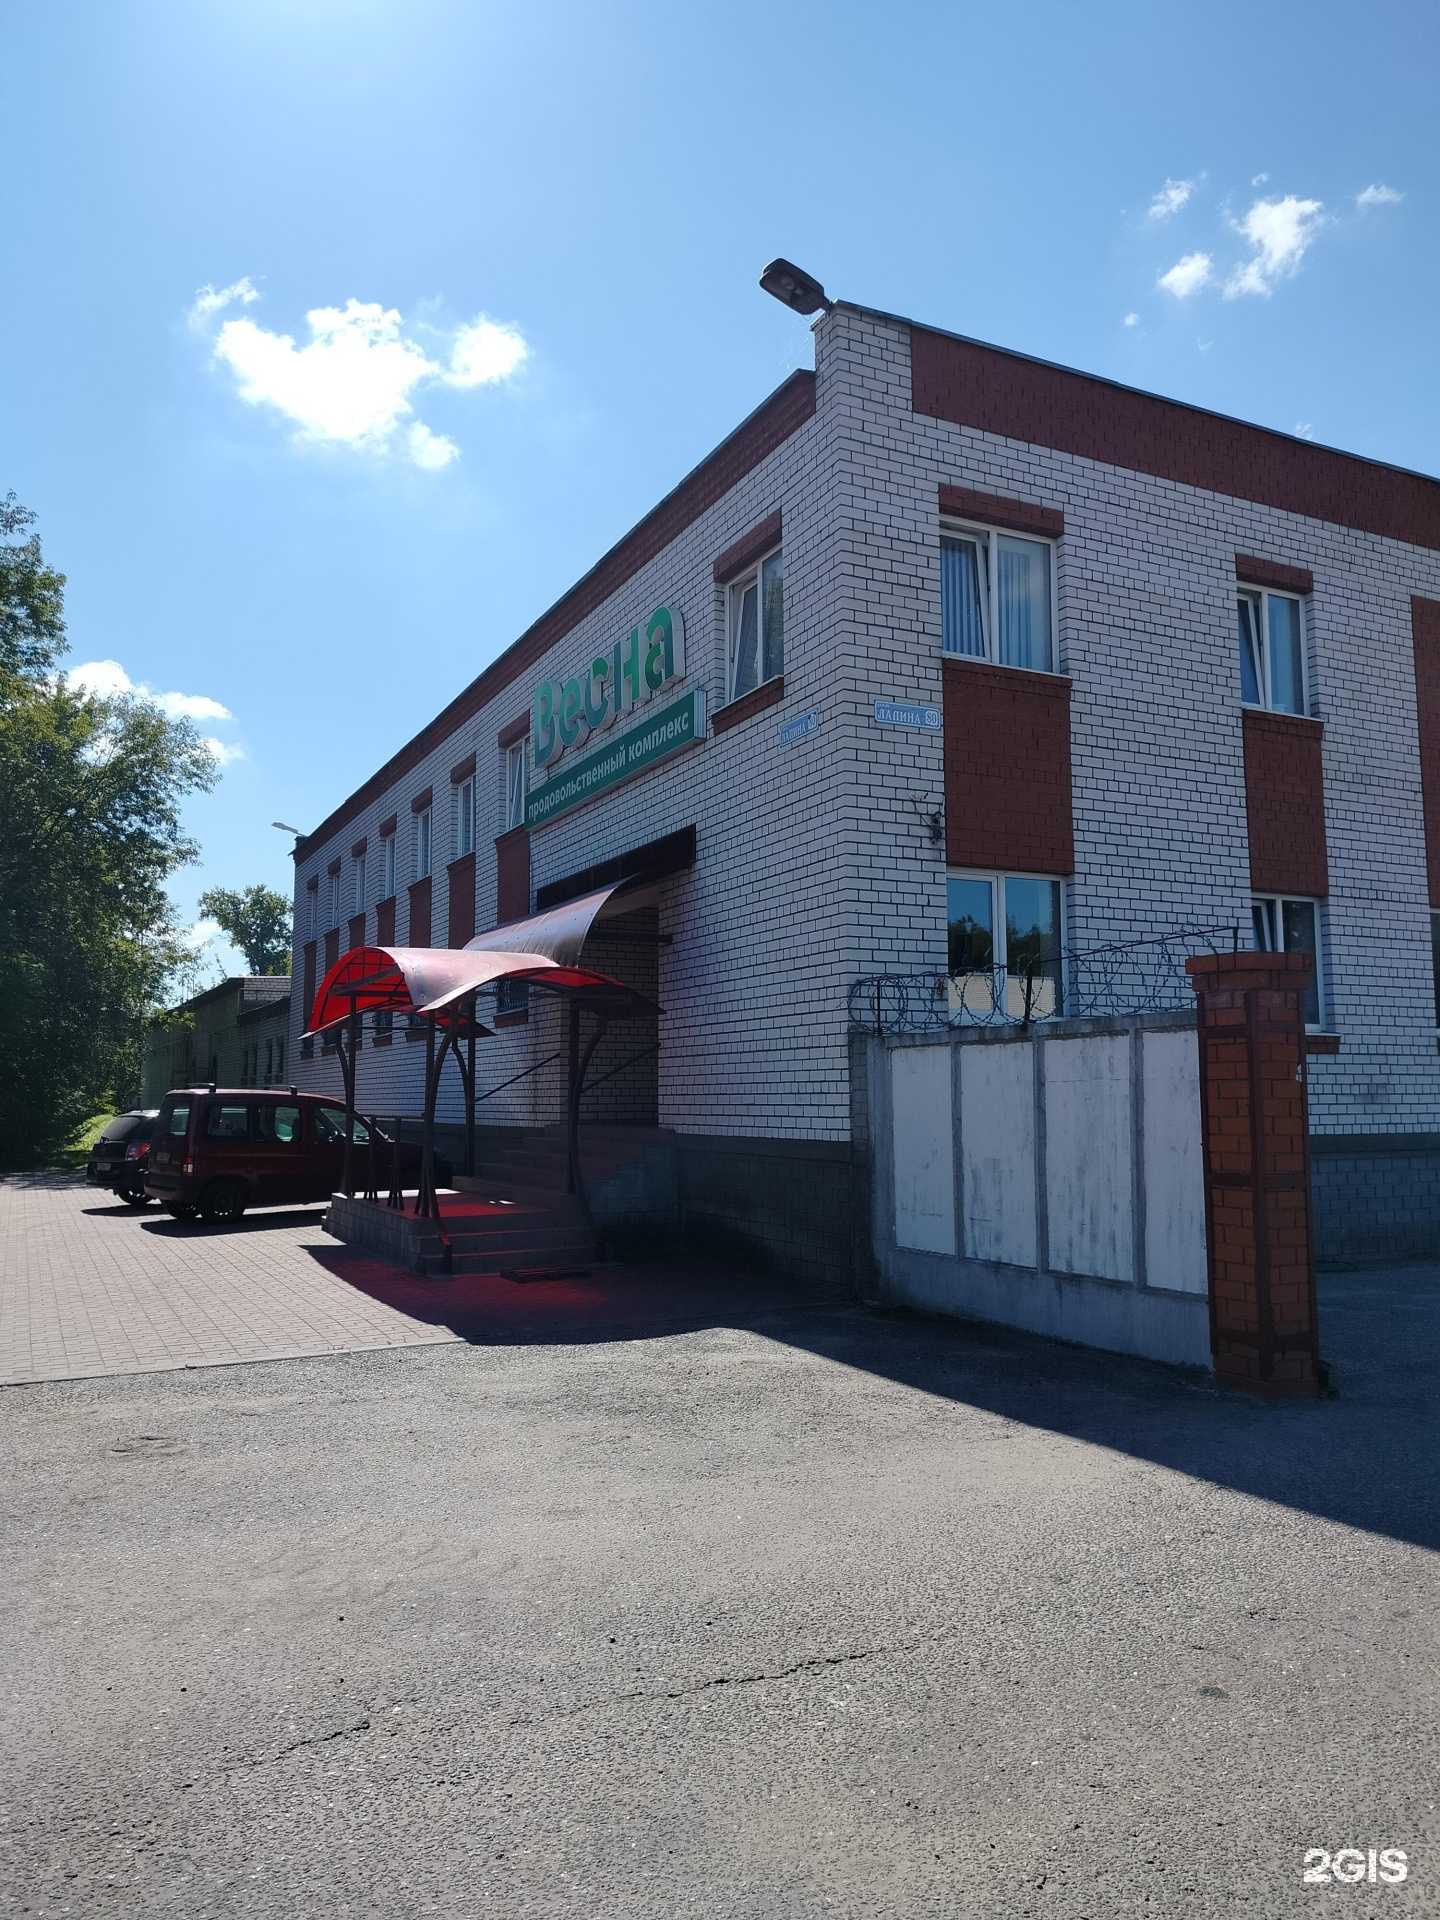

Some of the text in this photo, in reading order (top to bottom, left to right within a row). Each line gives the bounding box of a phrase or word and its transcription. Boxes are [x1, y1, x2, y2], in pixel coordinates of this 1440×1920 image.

[535, 606, 683, 769] Весна
[528, 711, 689, 821] продовольственный комплекс
